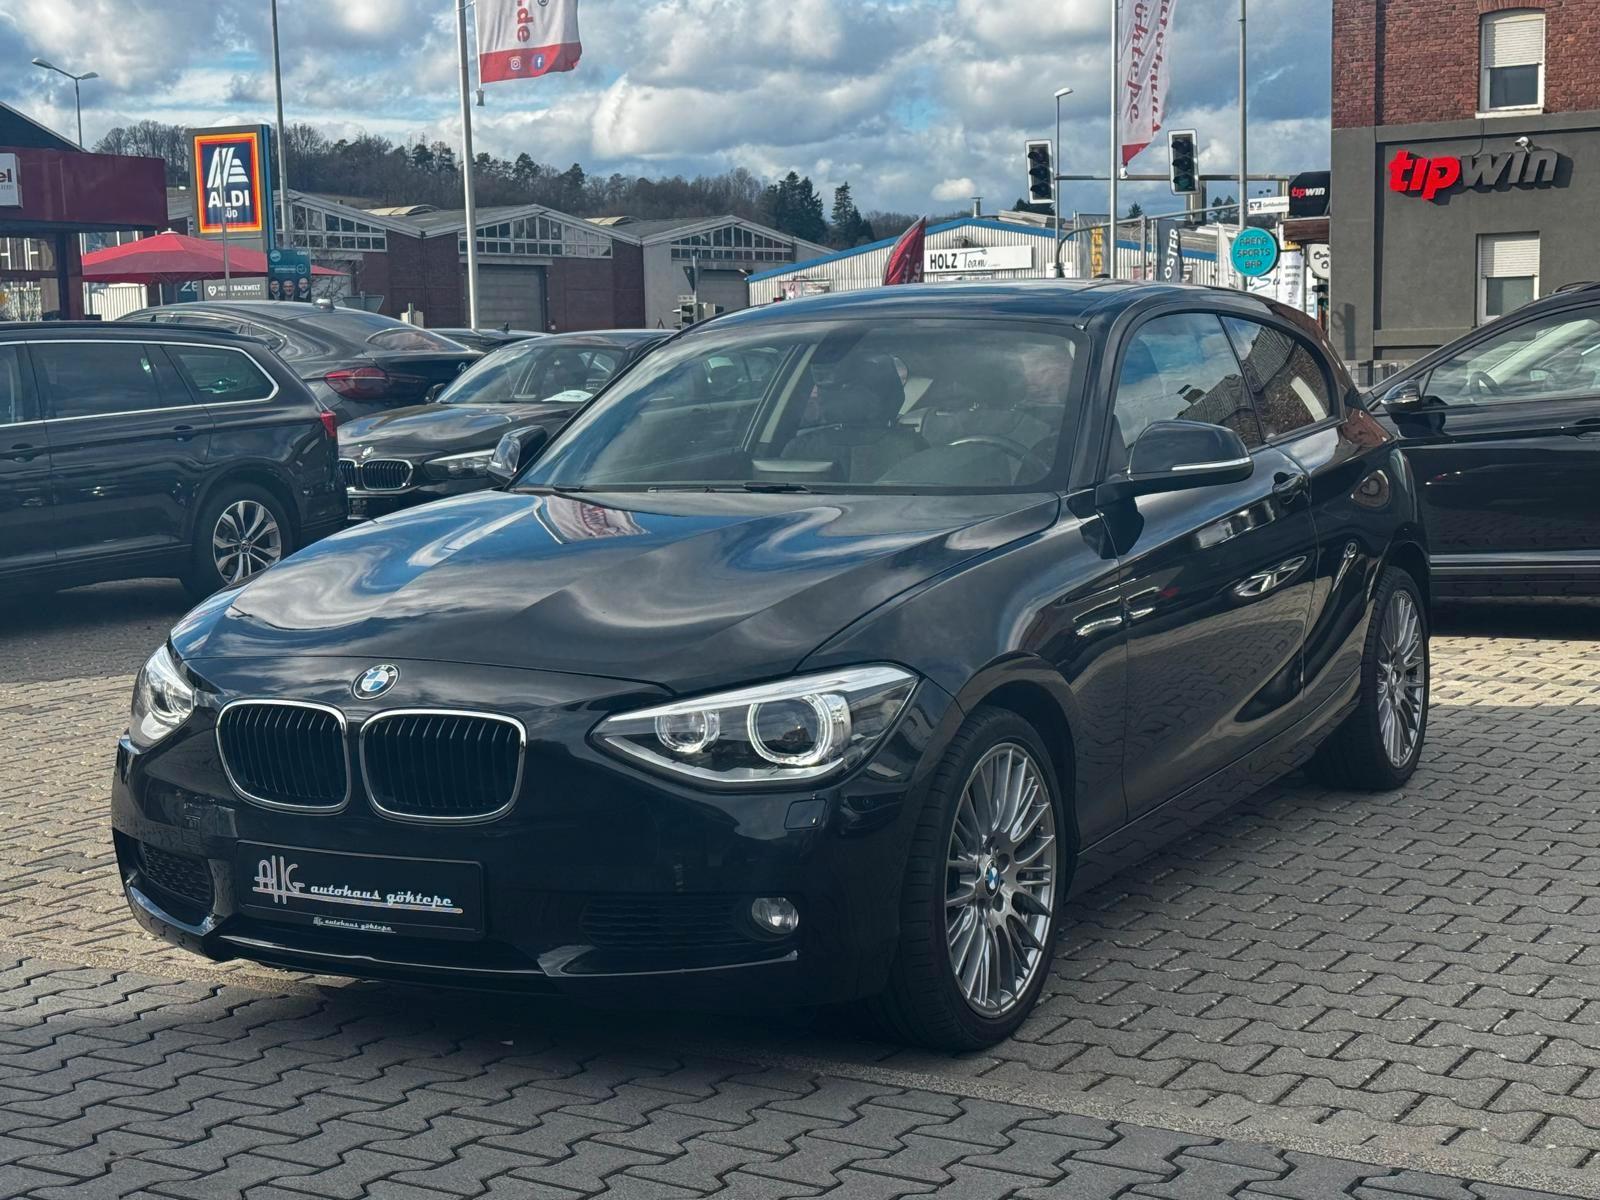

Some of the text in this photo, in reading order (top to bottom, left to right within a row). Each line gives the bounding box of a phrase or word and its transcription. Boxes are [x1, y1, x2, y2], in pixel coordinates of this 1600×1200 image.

[1388, 149, 1558, 201] tipwin
[208, 189, 251, 208] ALDI
[930, 253, 958, 270] HOLZ
[310, 884, 382, 901] autohaus
